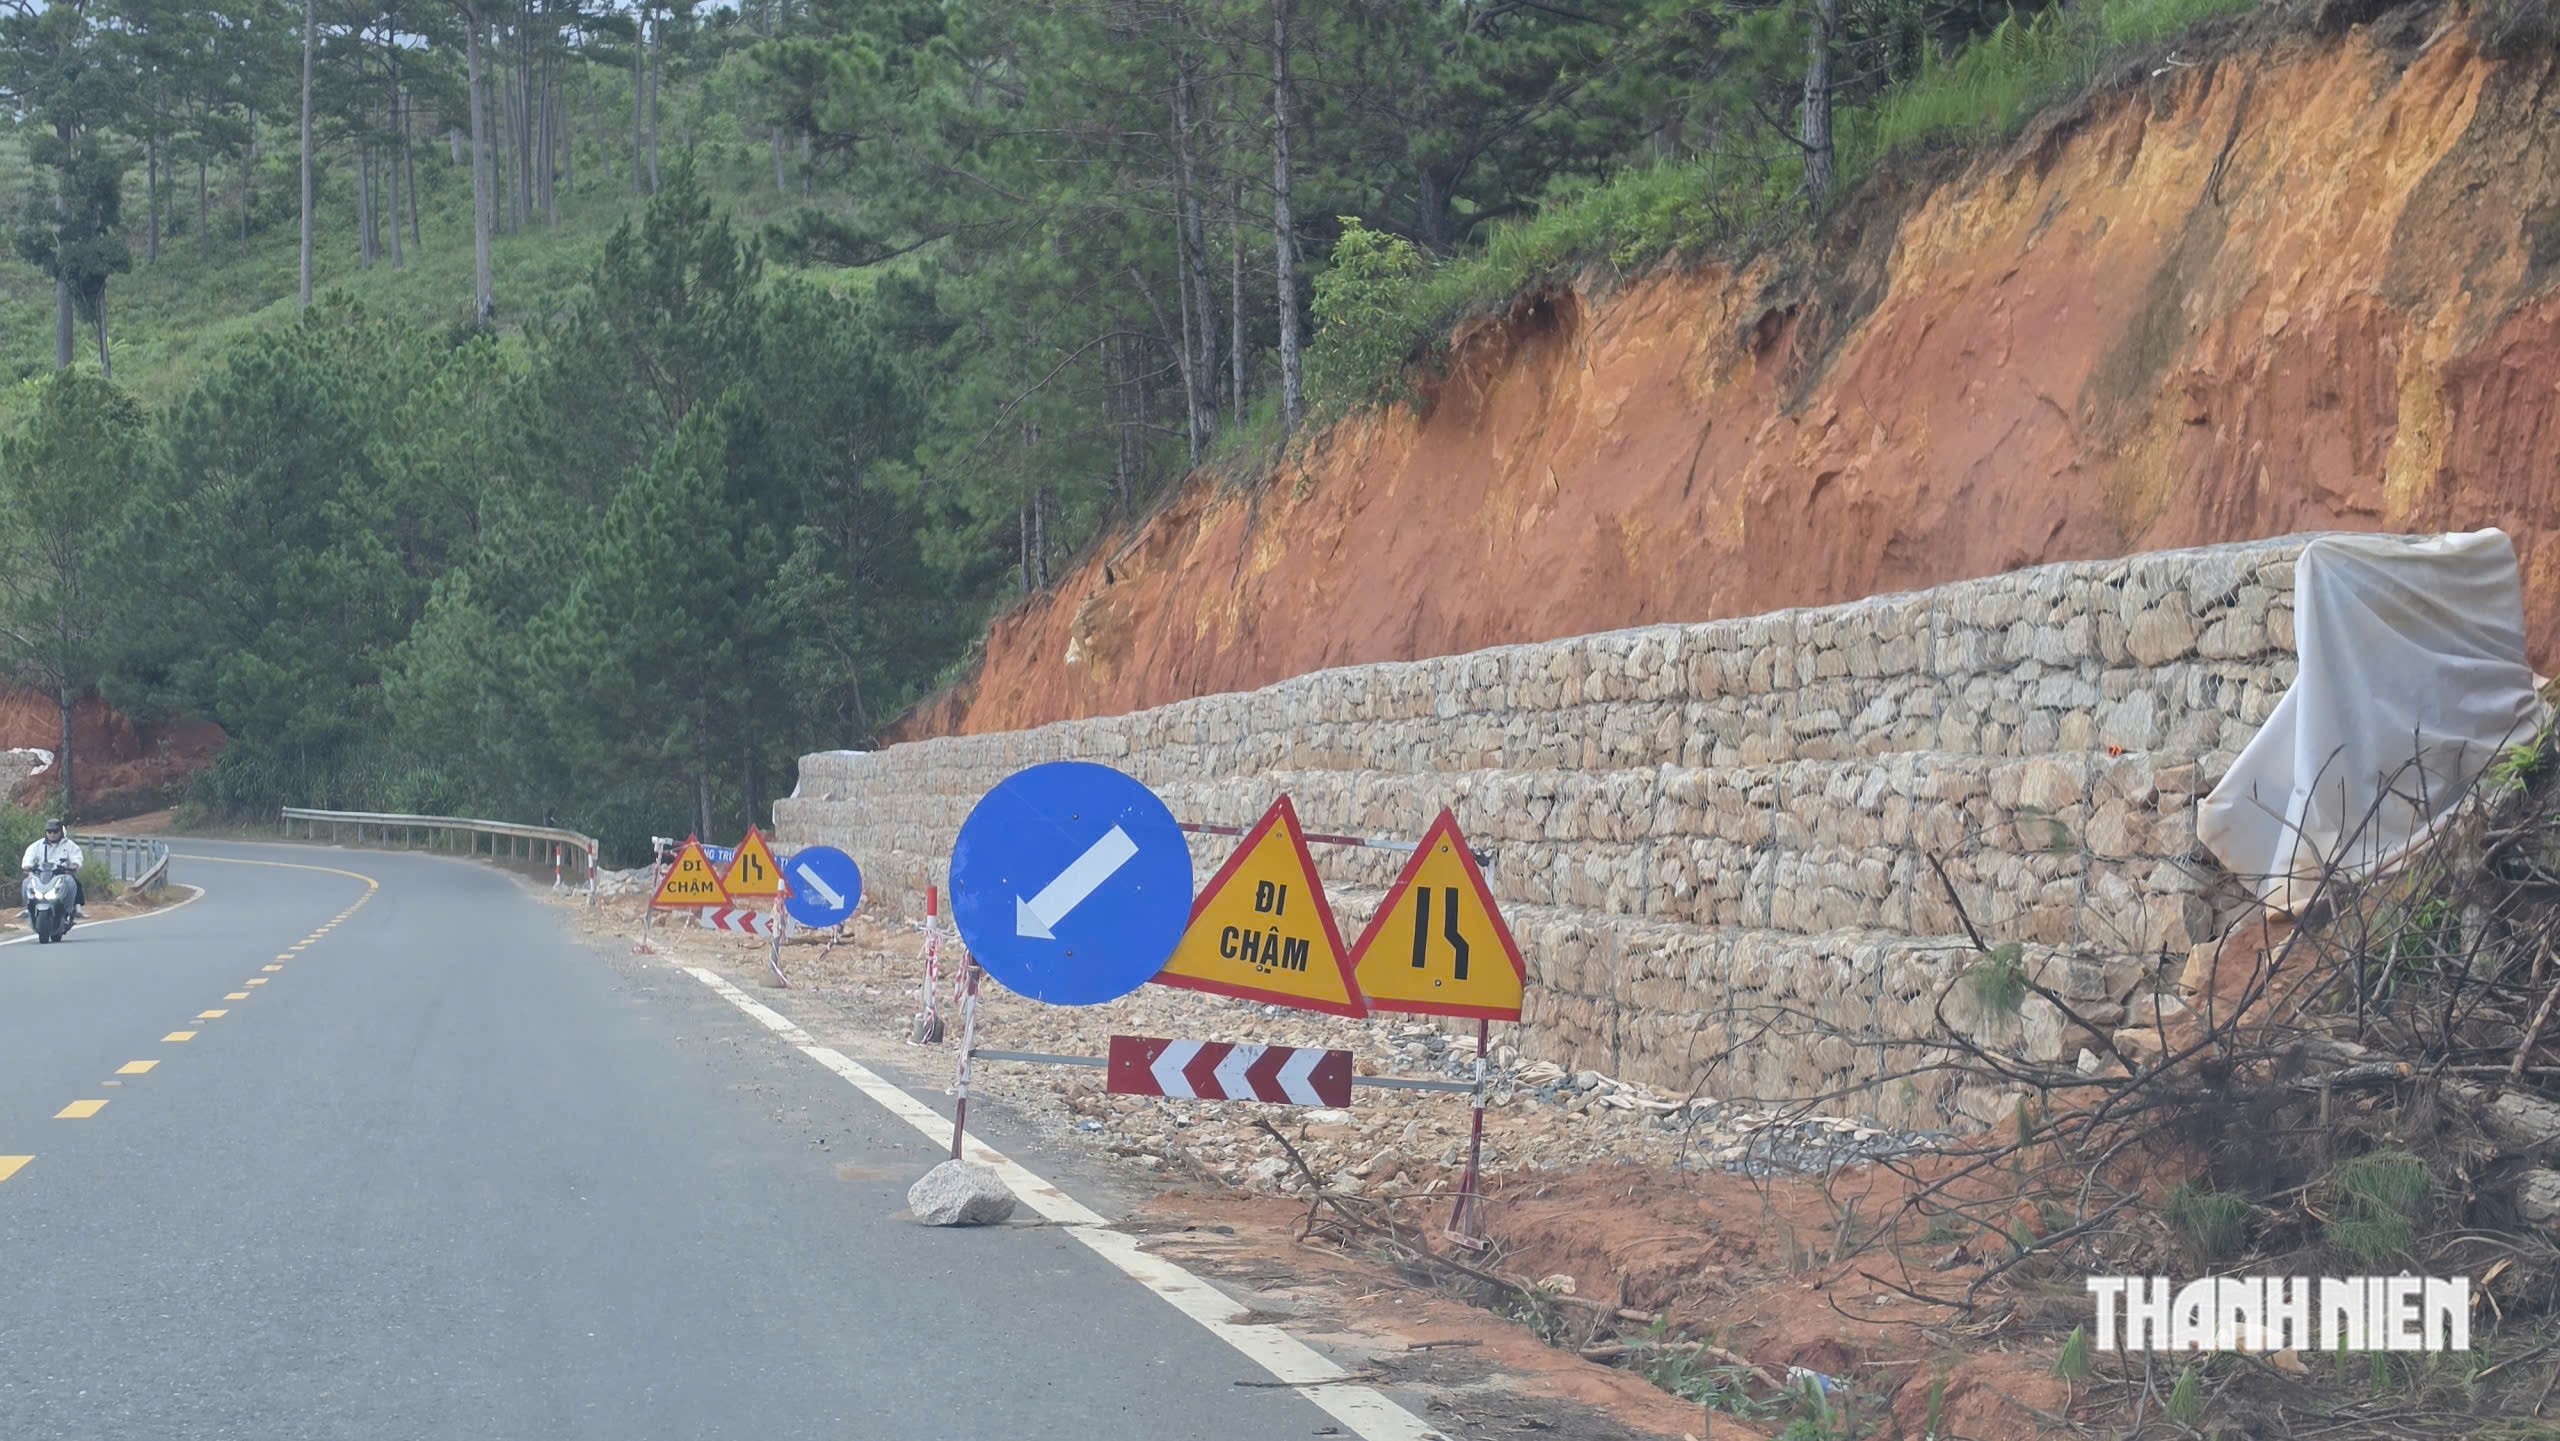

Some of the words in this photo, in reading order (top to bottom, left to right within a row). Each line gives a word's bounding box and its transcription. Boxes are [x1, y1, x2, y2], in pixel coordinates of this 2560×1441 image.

[683, 860, 702, 871] ĐI
[667, 878, 713, 896] CHẬM
[1255, 880, 1287, 916] ĐI
[1219, 926, 1310, 974] CHẬM
